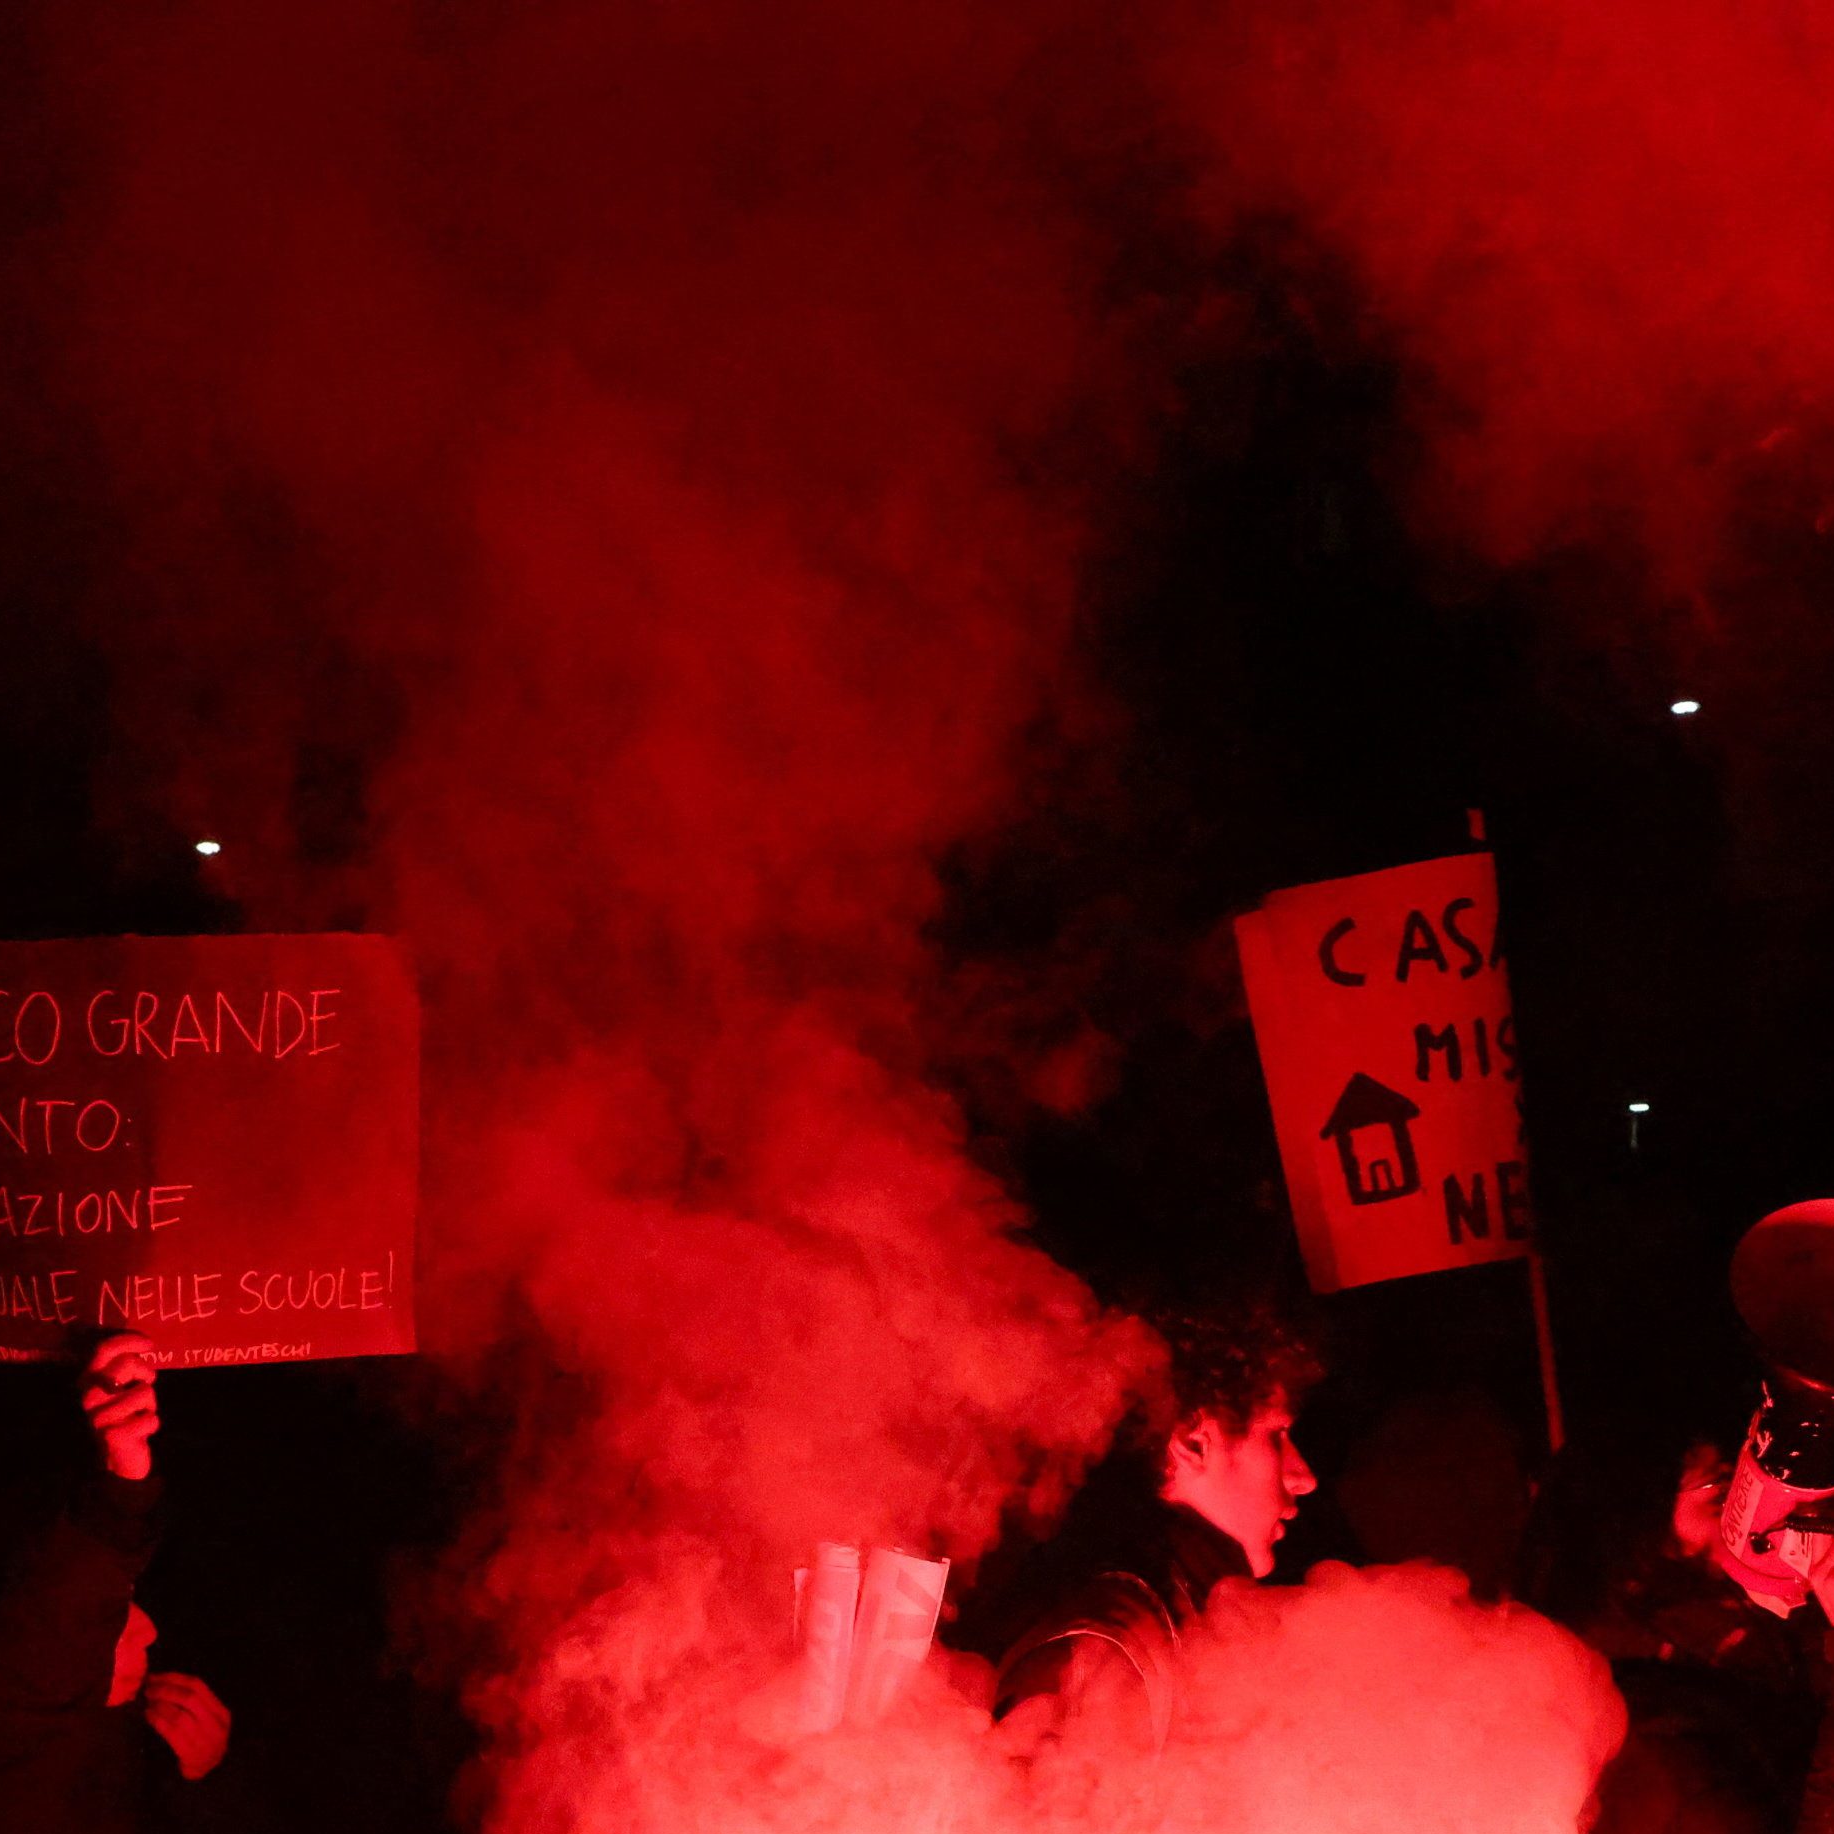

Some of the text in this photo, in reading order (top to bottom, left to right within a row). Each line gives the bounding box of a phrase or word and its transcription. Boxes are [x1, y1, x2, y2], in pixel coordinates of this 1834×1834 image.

[1318, 897, 1507, 987] CAS
[87, 988, 341, 1060] GRANDE
[98, 1273, 223, 1326] NELLE
[238, 1251, 394, 1315] SCUOLE!
